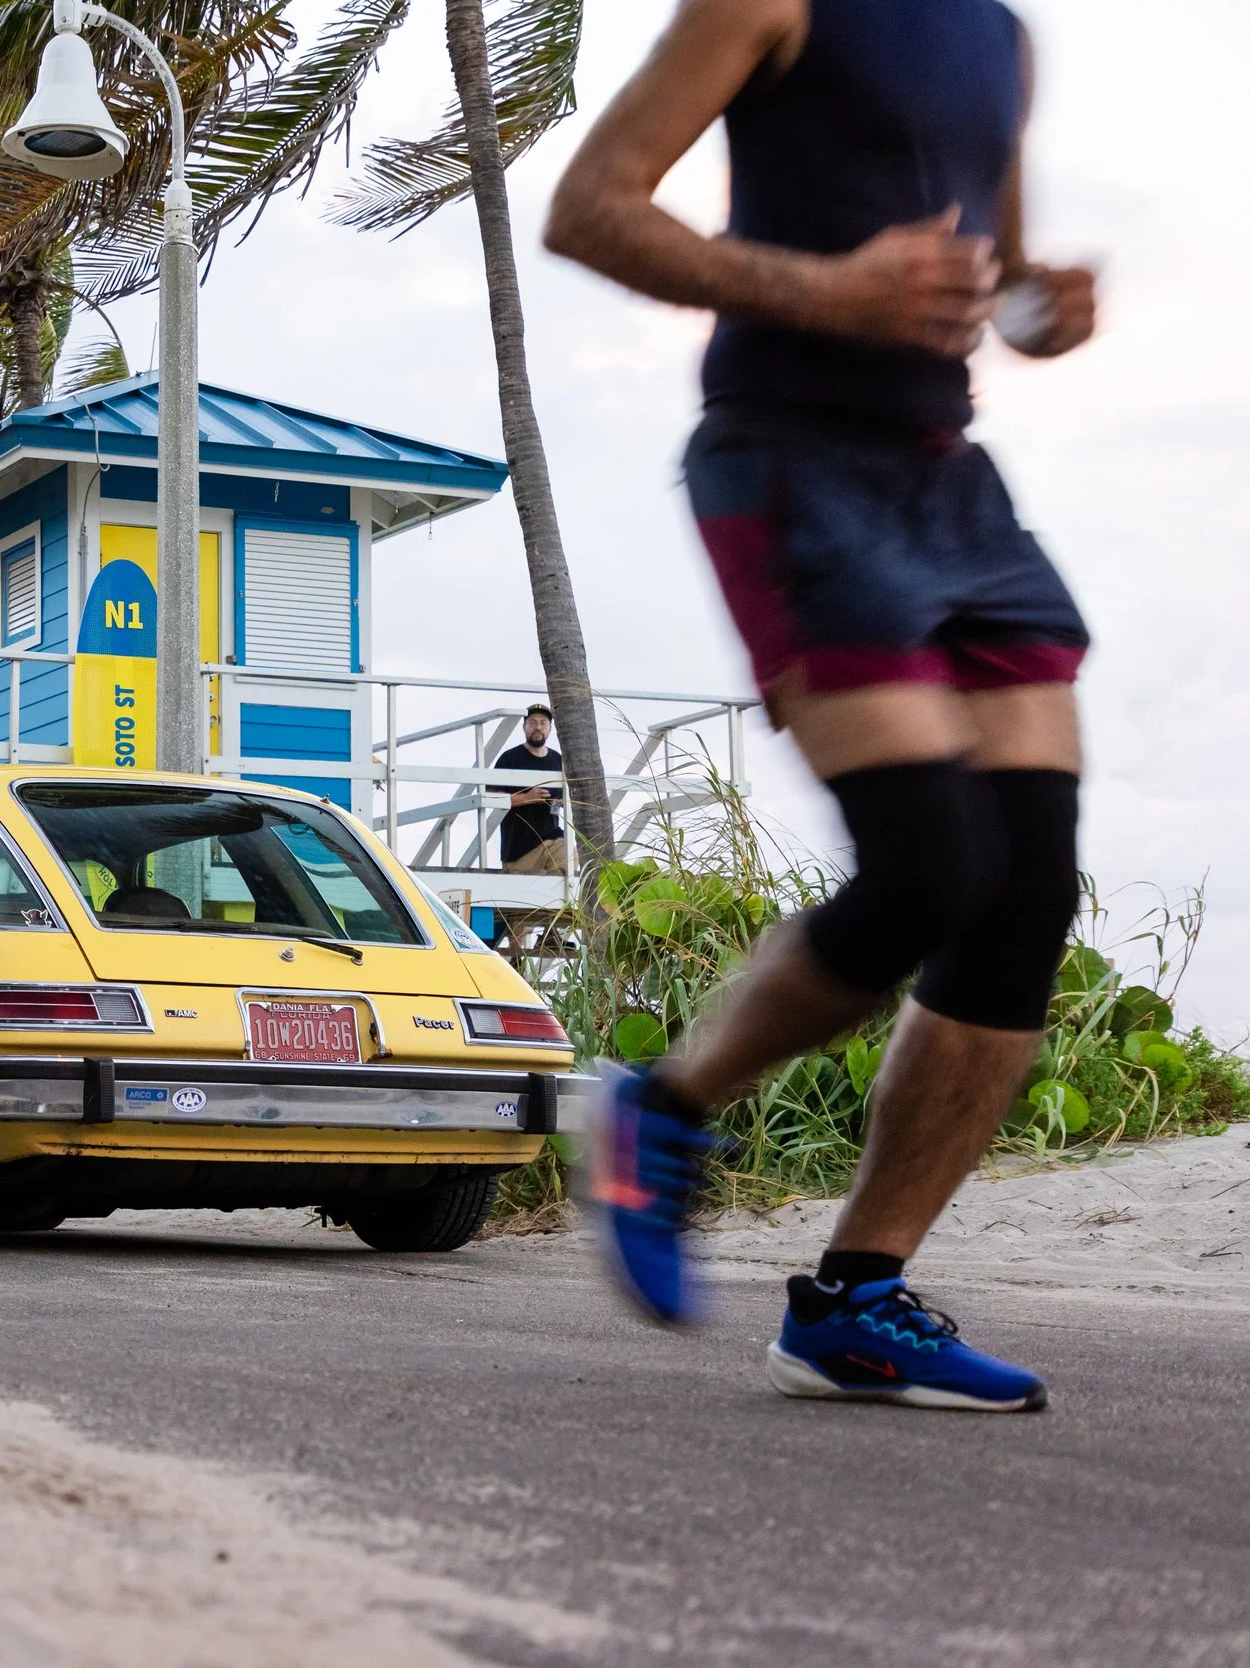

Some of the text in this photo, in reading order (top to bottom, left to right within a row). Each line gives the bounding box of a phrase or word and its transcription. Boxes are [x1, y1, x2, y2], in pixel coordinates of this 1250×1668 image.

[105, 600, 144, 630] N1
[115, 684, 136, 767] SOTO ST
[273, 1003, 329, 1012] DANIA FLA
[178, 1010, 199, 1018] AMC
[271, 1012, 330, 1020] FLORIDA
[413, 1016, 454, 1030] Pacer
[255, 1051, 267, 1059] 68
[274, 1052, 335, 1061] SUNSHINE STATE
[343, 1053, 355, 1061] 69
[129, 1091, 152, 1099] ARCO
[178, 1091, 201, 1106] AAA
[497, 1102, 515, 1116] AAA
